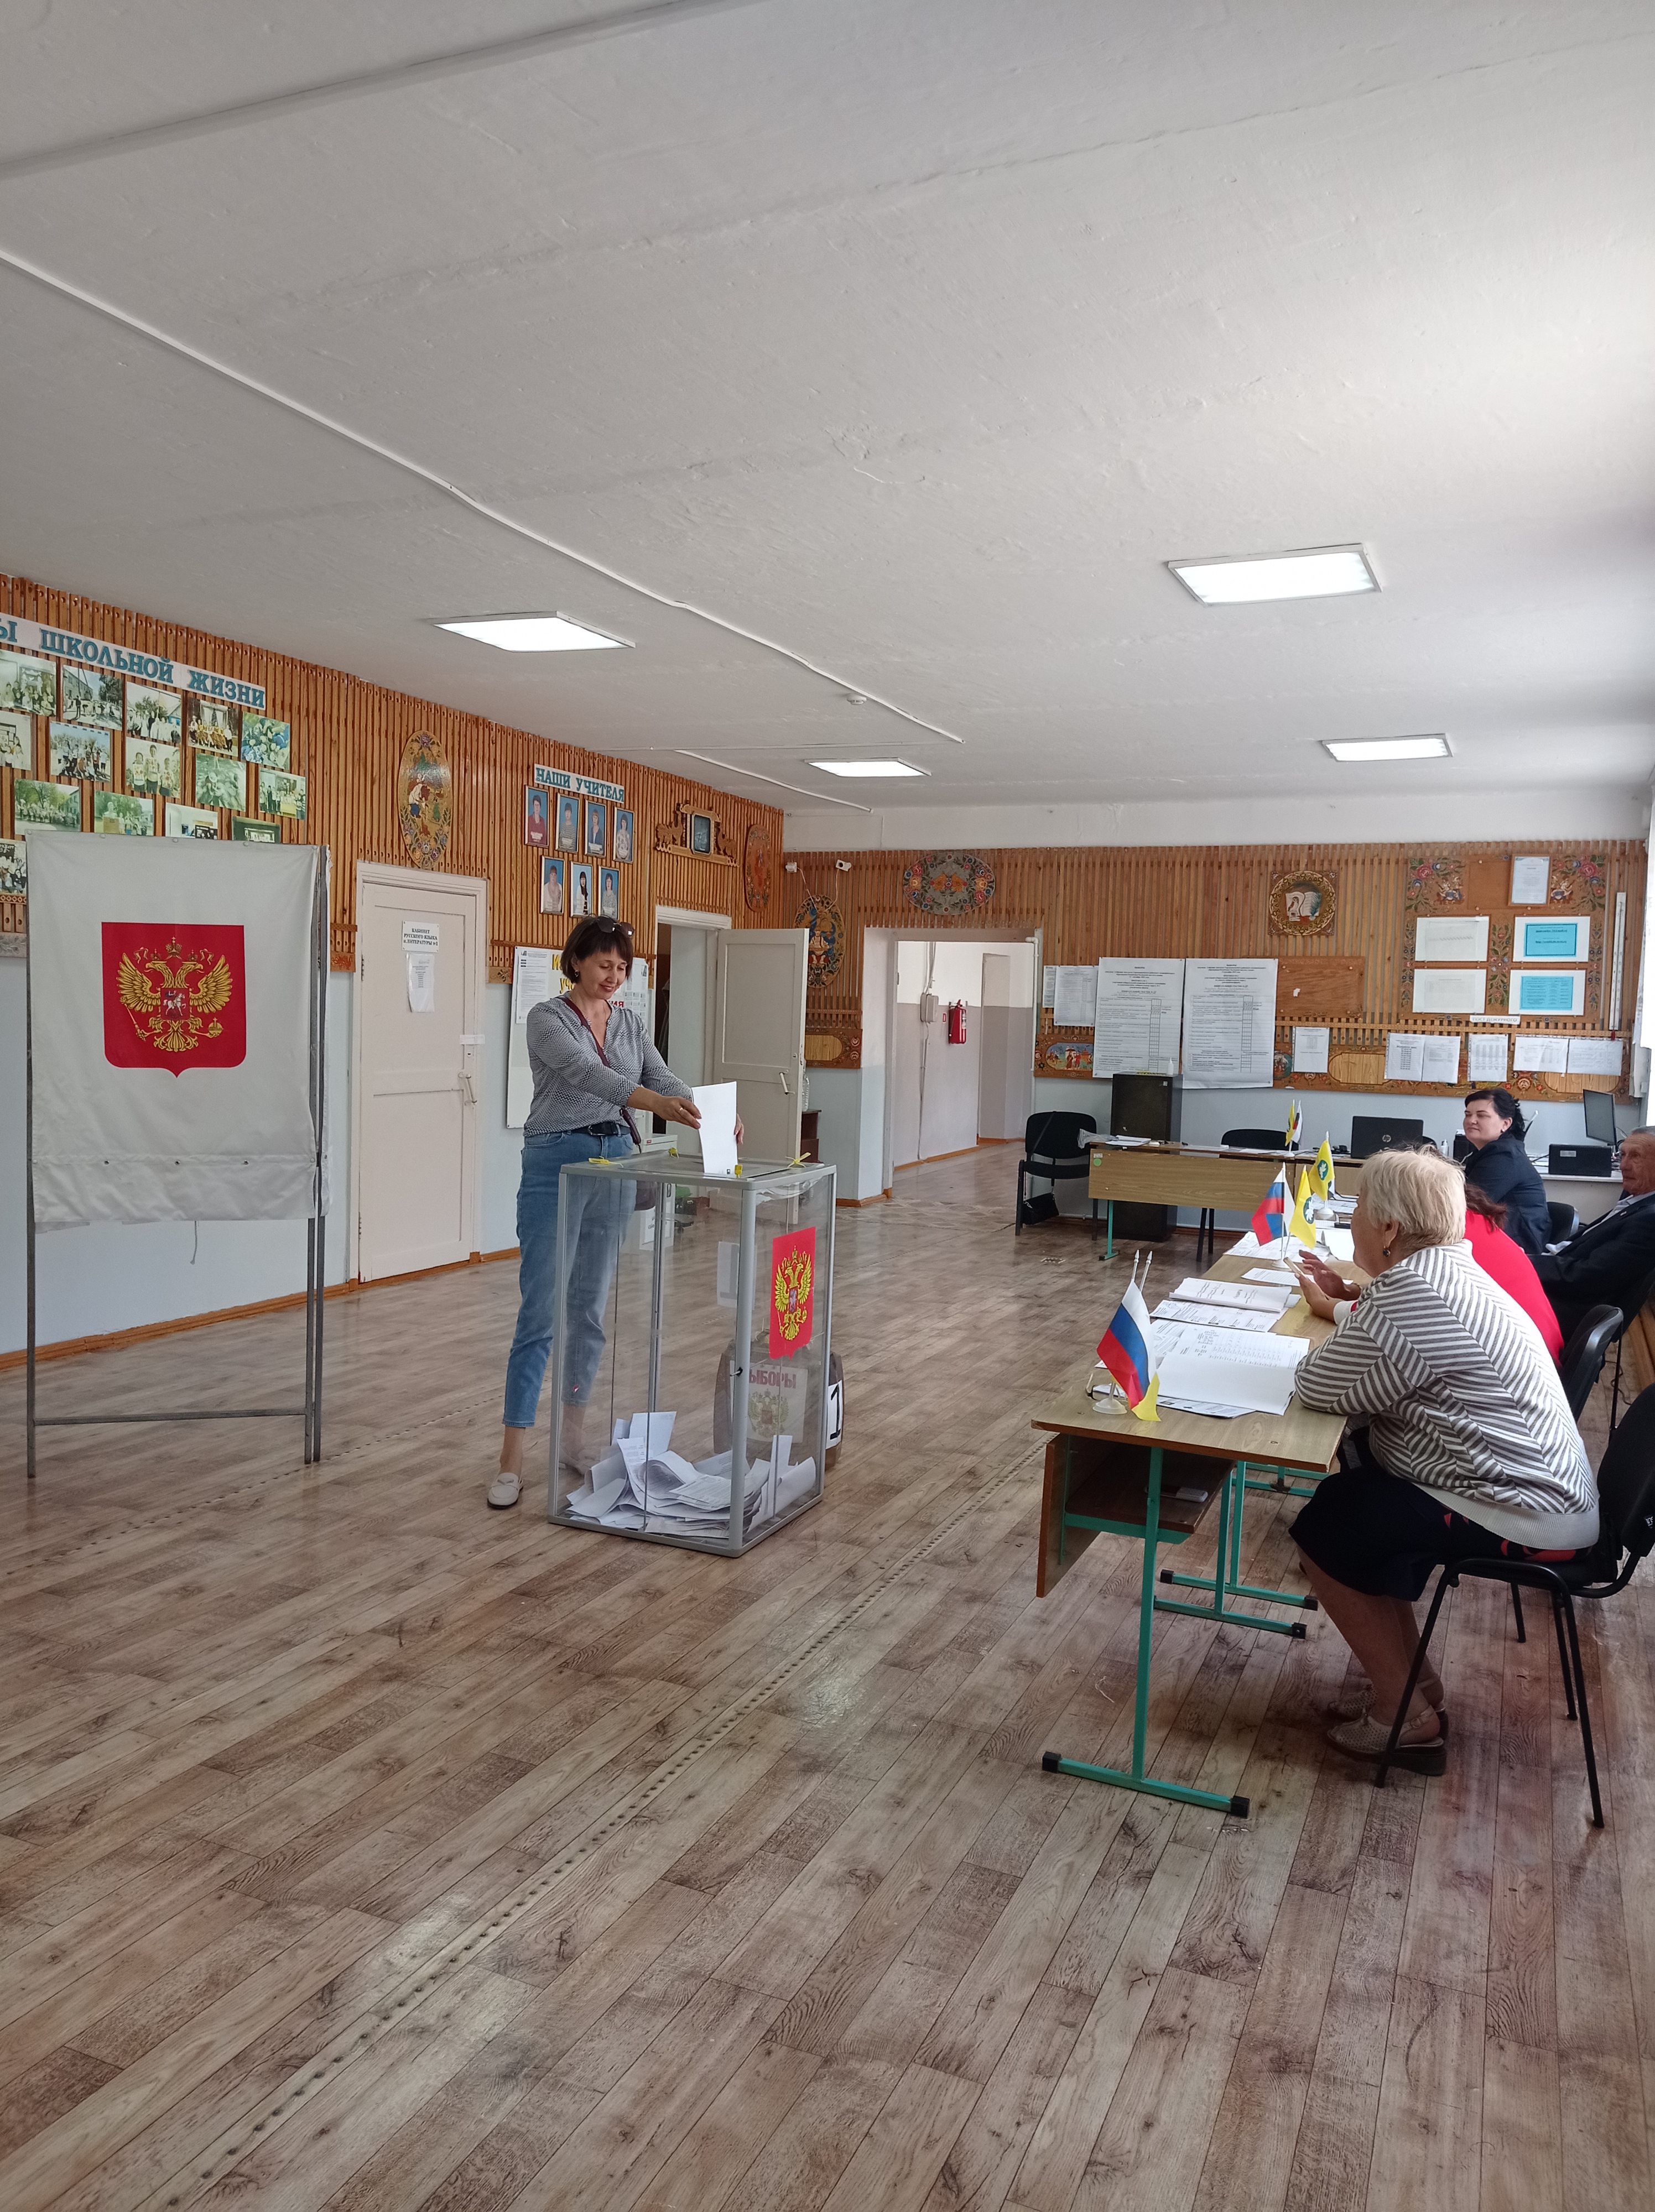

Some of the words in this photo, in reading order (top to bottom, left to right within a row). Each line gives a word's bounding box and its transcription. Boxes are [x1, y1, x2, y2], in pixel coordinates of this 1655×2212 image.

[40, 629, 174, 684] ШКОЛЬНОЙ
[188, 670, 265, 708] ЖИЗНИ
[535, 767, 570, 789] НАШИ
[576, 778, 624, 802] УЧИТЕЛЯ
[749, 1369, 797, 1389] ЫБОРЫ
[830, 1383, 841, 1440] 1
